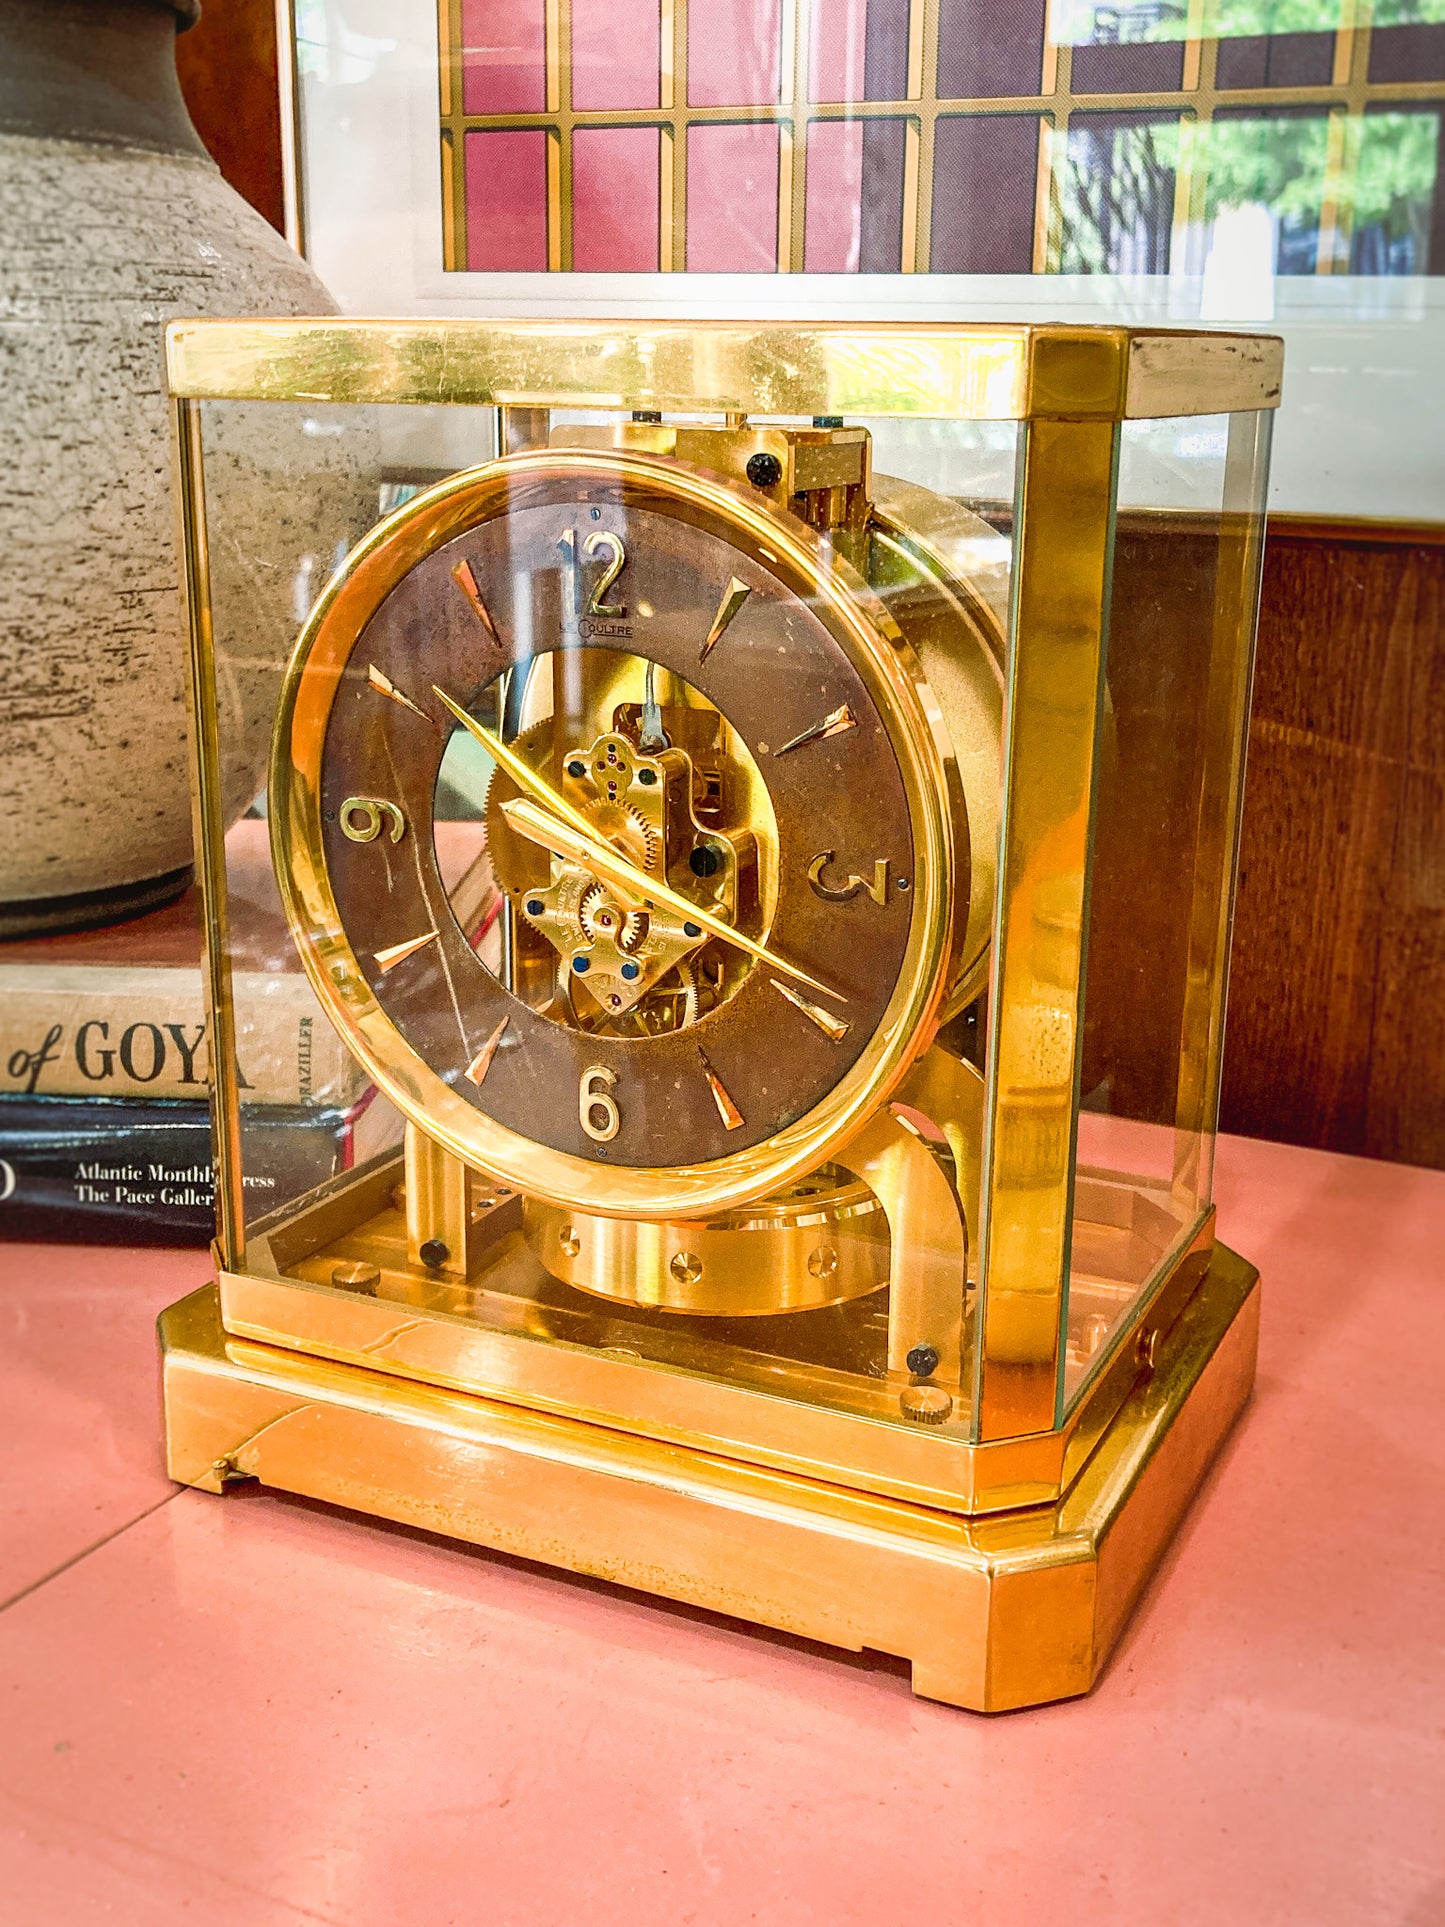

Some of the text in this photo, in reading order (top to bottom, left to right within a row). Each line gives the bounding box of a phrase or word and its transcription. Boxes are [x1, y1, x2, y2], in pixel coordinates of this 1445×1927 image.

[556, 529, 625, 617] 12
[578, 619, 633, 638] COULTRE
[340, 797, 405, 844] 9
[808, 851, 887, 906] 3
[8, 1023, 63, 1094] of
[579, 1066, 620, 1142] 6
[74, 1162, 143, 1181] Atlantic
[242, 1175, 276, 1188] ress
[74, 1184, 215, 1207] The Pace Galler
